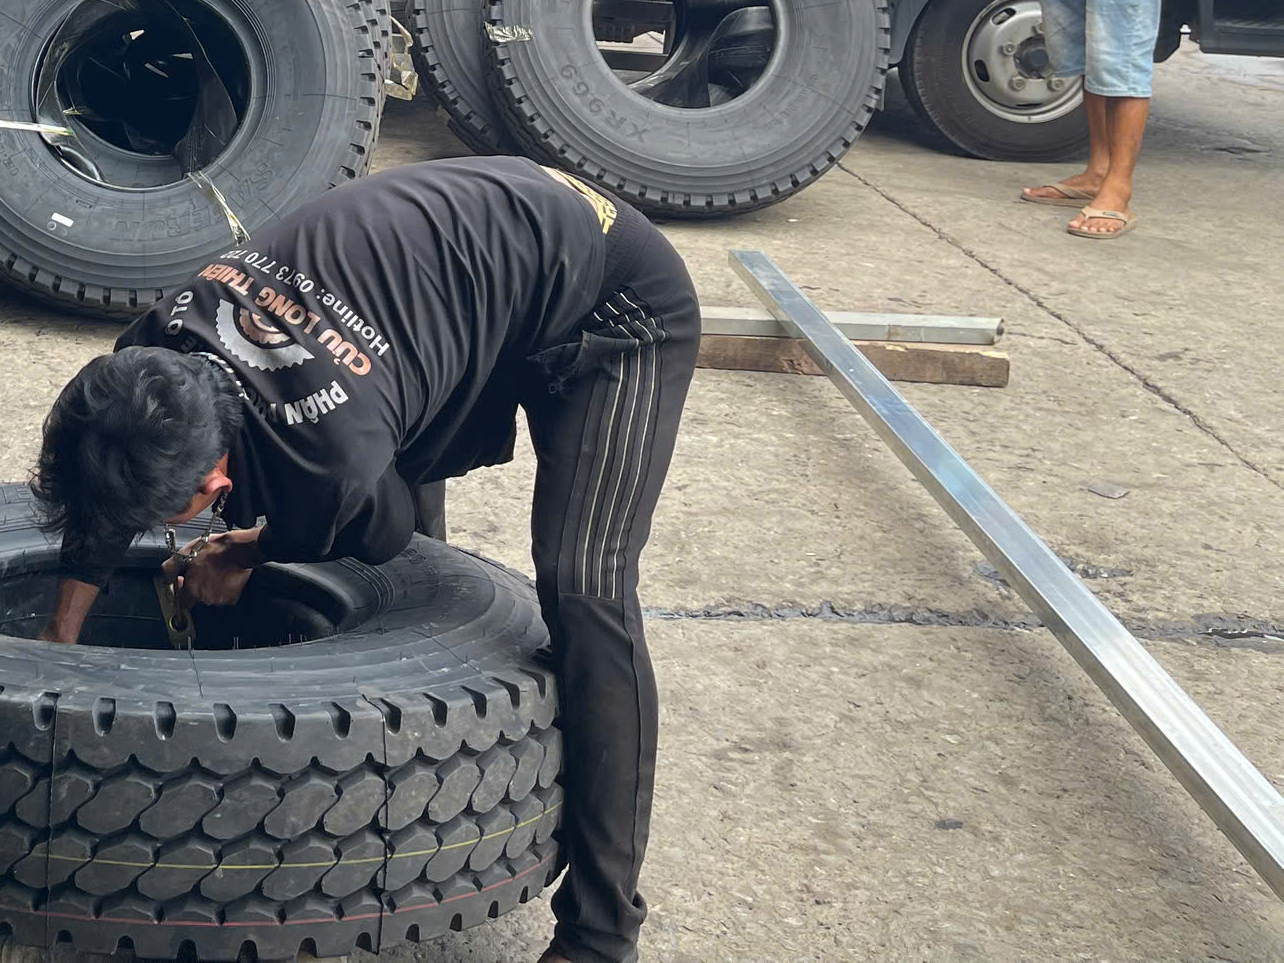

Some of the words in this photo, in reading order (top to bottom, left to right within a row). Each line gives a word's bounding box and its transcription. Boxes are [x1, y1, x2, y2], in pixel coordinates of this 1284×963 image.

[196, 263, 256, 296] THIÊN
[244, 252, 276, 274] 770
[275, 265, 315, 293] 0973
[254, 287, 321, 334] LONG
[315, 288, 390, 357] Hotline:
[317, 328, 372, 376] CỬU
[284, 380, 349, 425] PHÂN
